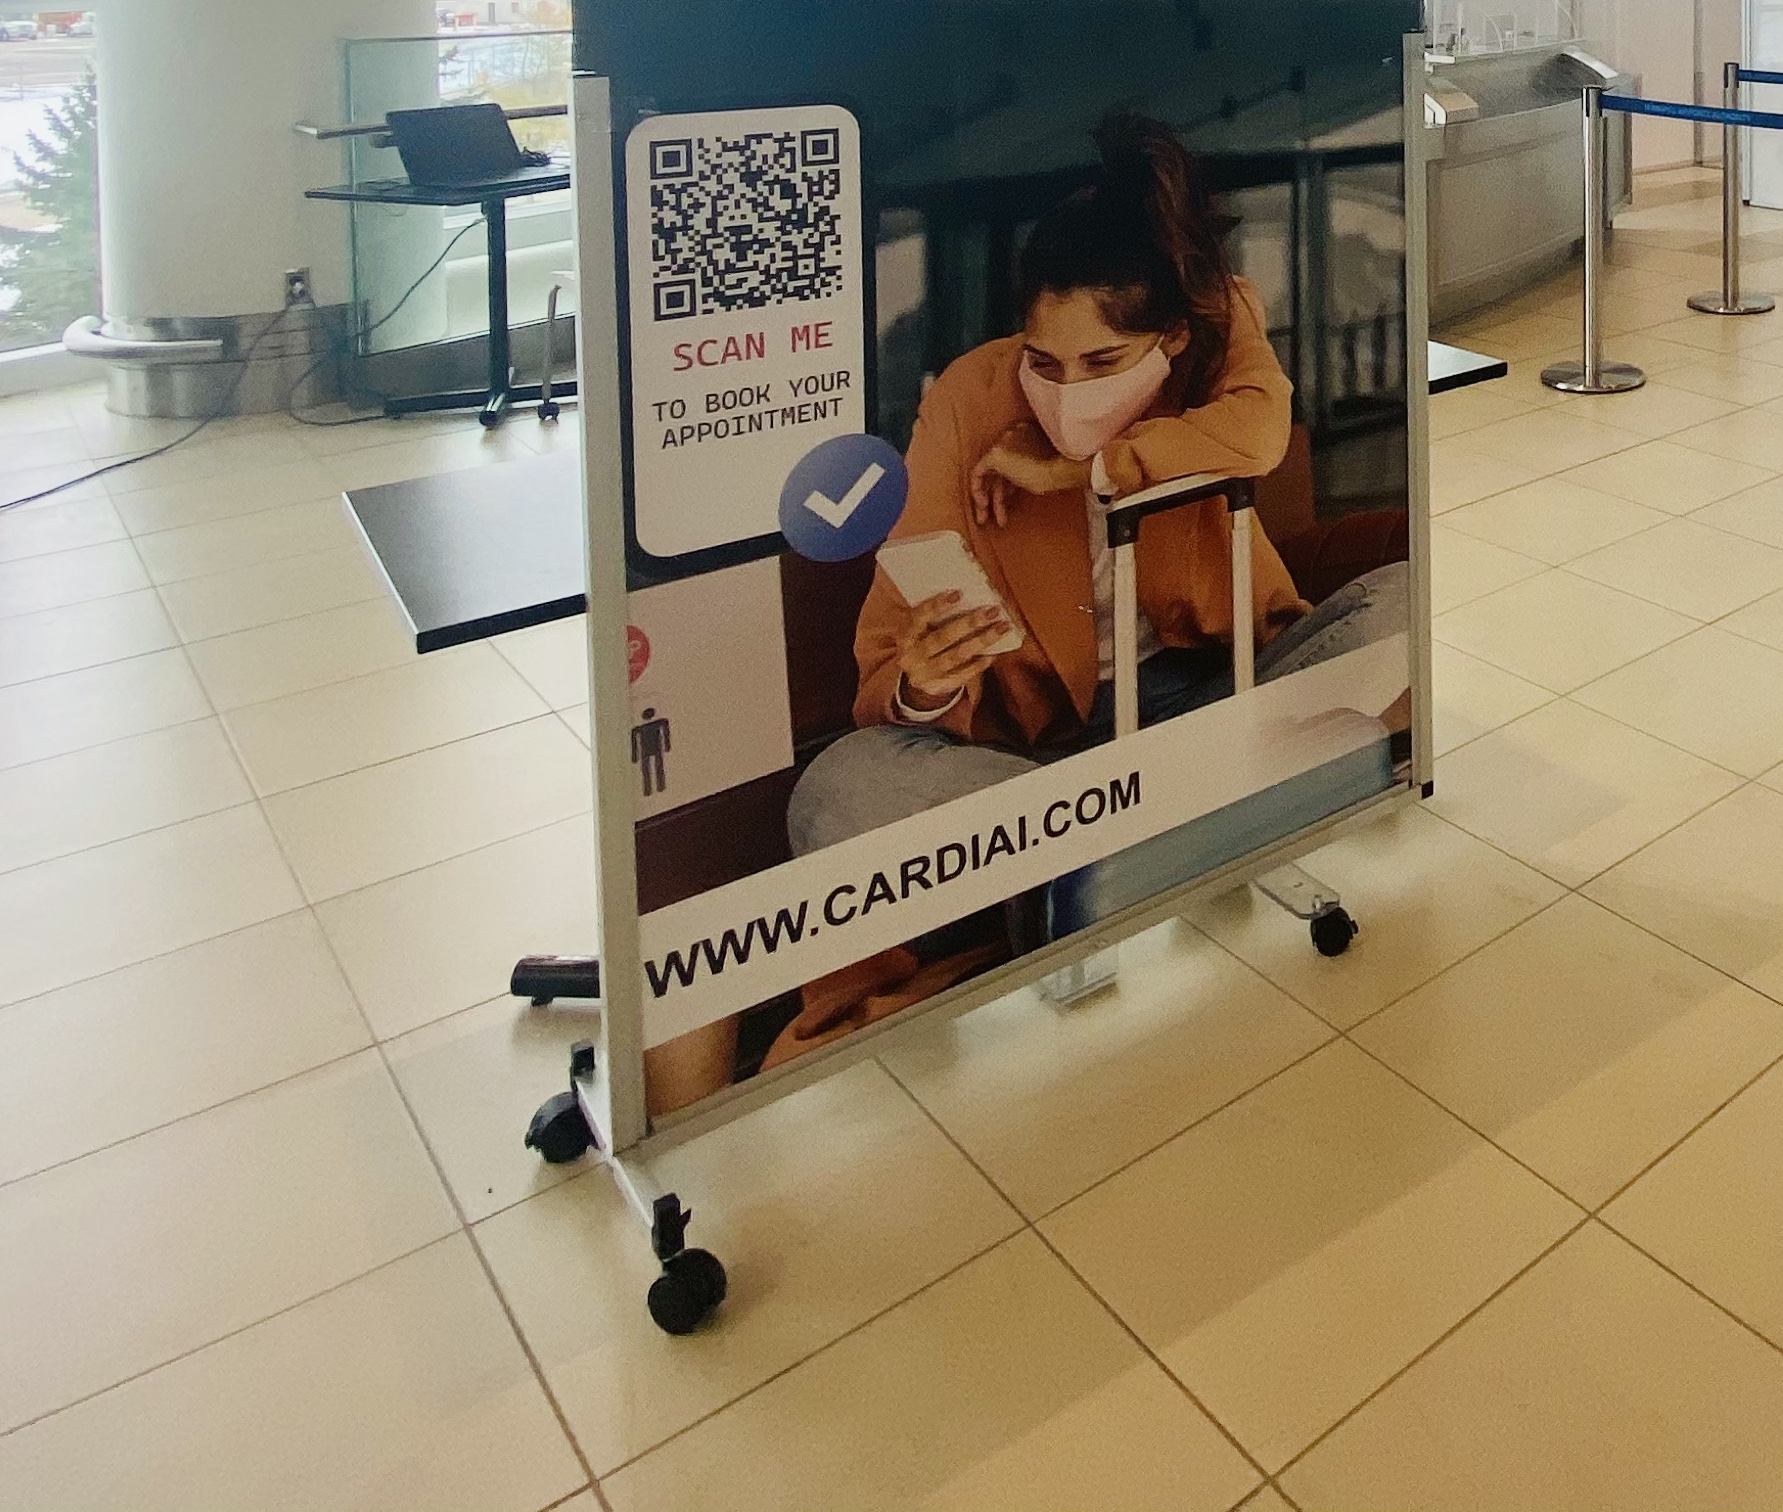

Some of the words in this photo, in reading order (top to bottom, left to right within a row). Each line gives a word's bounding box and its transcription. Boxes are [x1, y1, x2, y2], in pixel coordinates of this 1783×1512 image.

[673, 331, 765, 372] SCAN
[790, 321, 834, 354] ME
[652, 399, 686, 423] TO
[705, 383, 771, 414] BOOK
[789, 370, 851, 399] YOUR
[661, 397, 844, 450] APPOINTMENT
[644, 771, 1142, 1000] WWW.CARDIAI.COM
